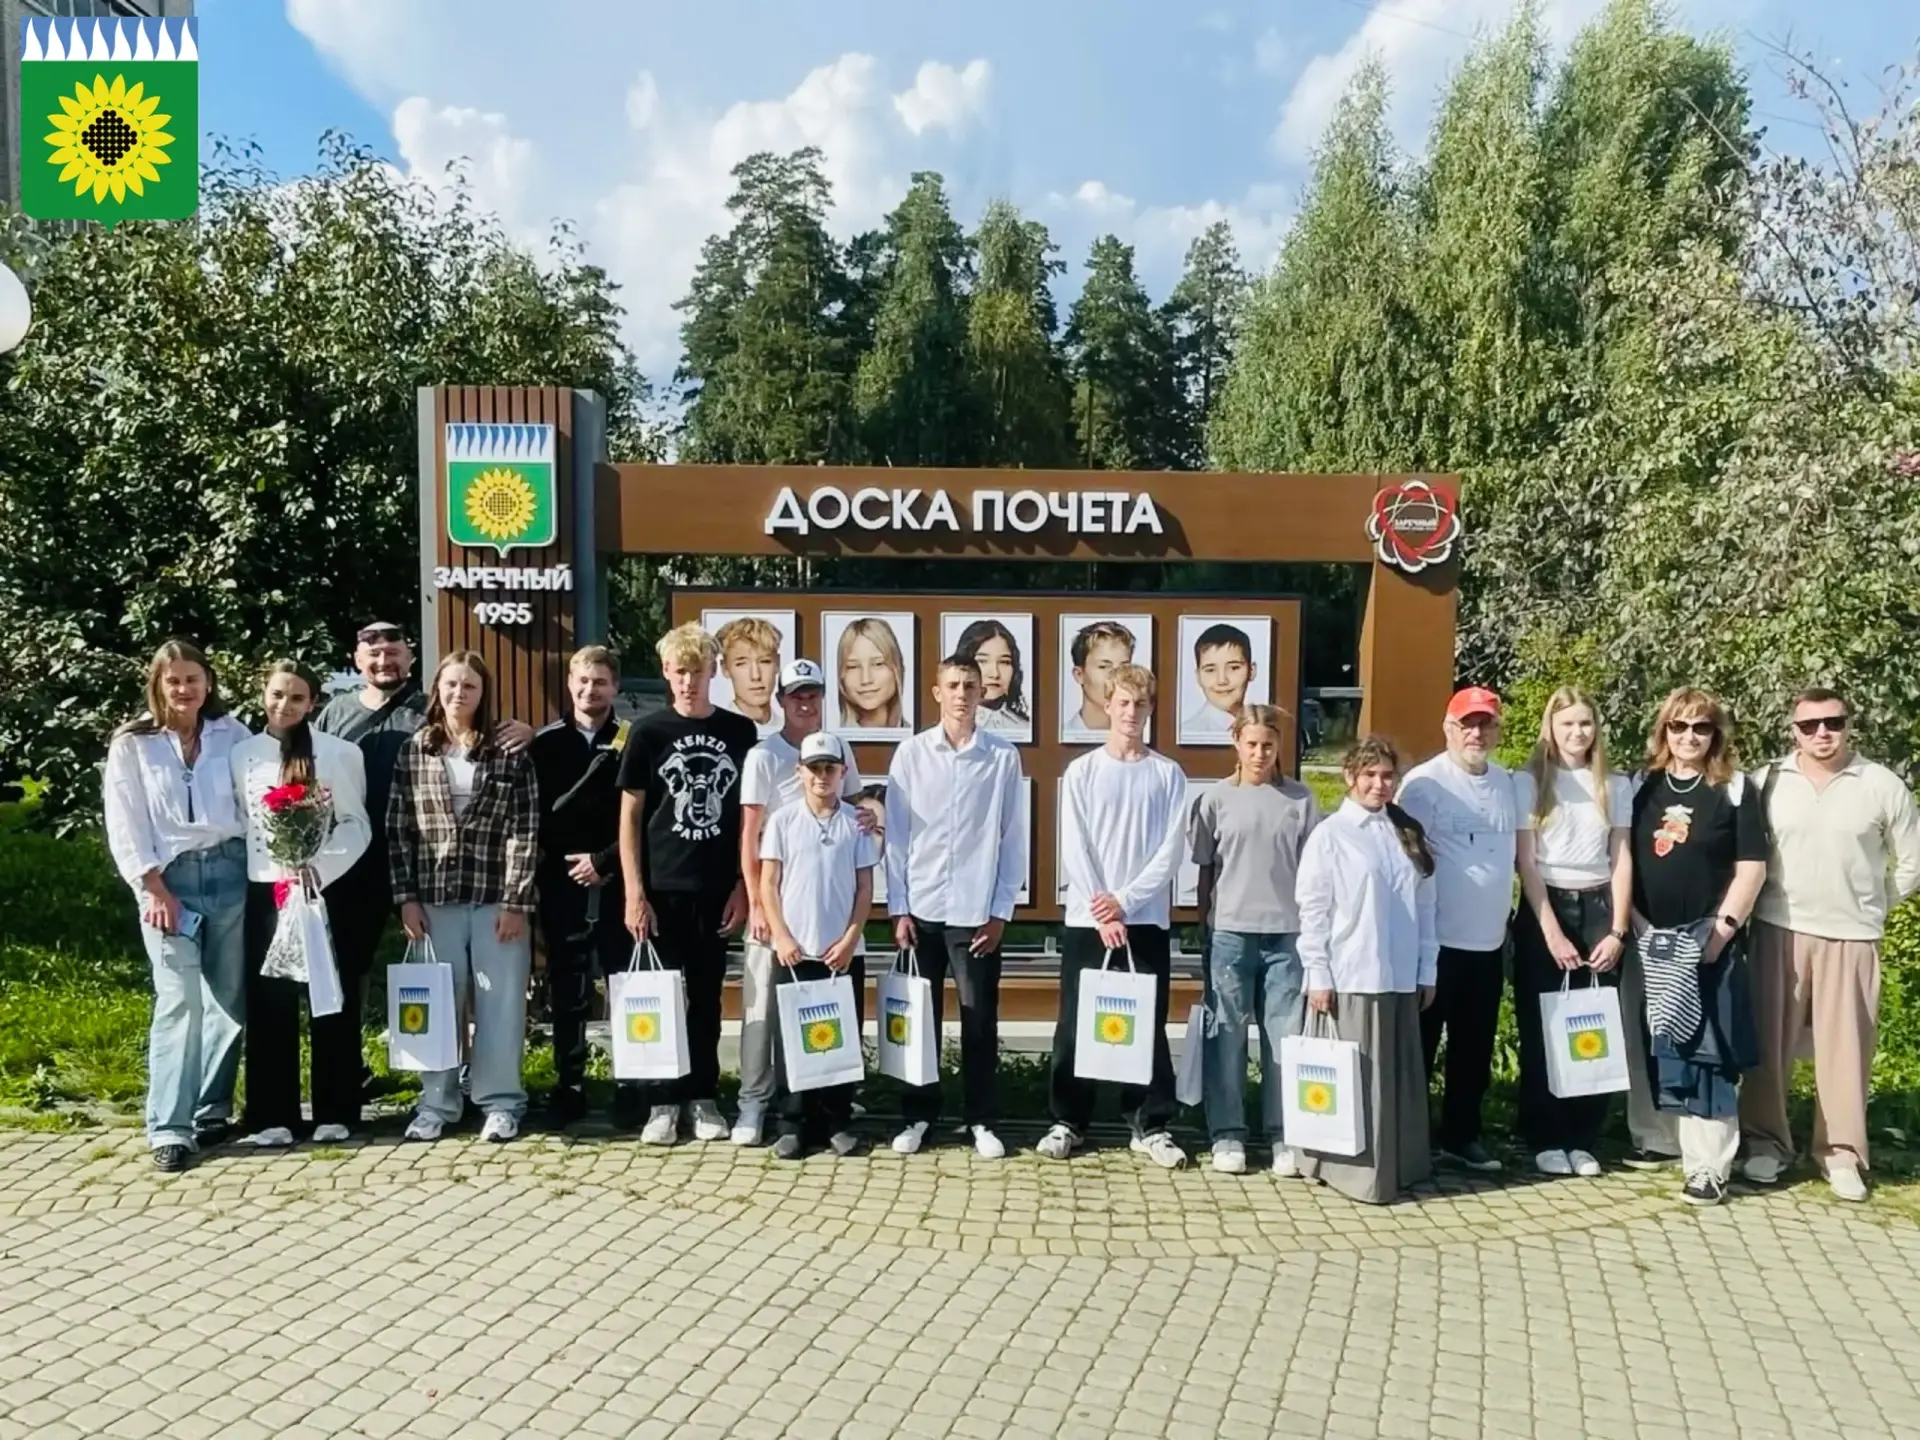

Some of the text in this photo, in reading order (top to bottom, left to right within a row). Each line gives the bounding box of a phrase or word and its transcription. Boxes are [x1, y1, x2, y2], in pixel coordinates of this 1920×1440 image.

[764, 486, 1164, 536] ДОСКА ПОЧЕТА
[433, 563, 574, 591] ЗАРЕЧНЫЙ
[473, 602, 533, 625] 1955
[673, 734, 727, 752] KENZO
[671, 822, 721, 841] PARIS
